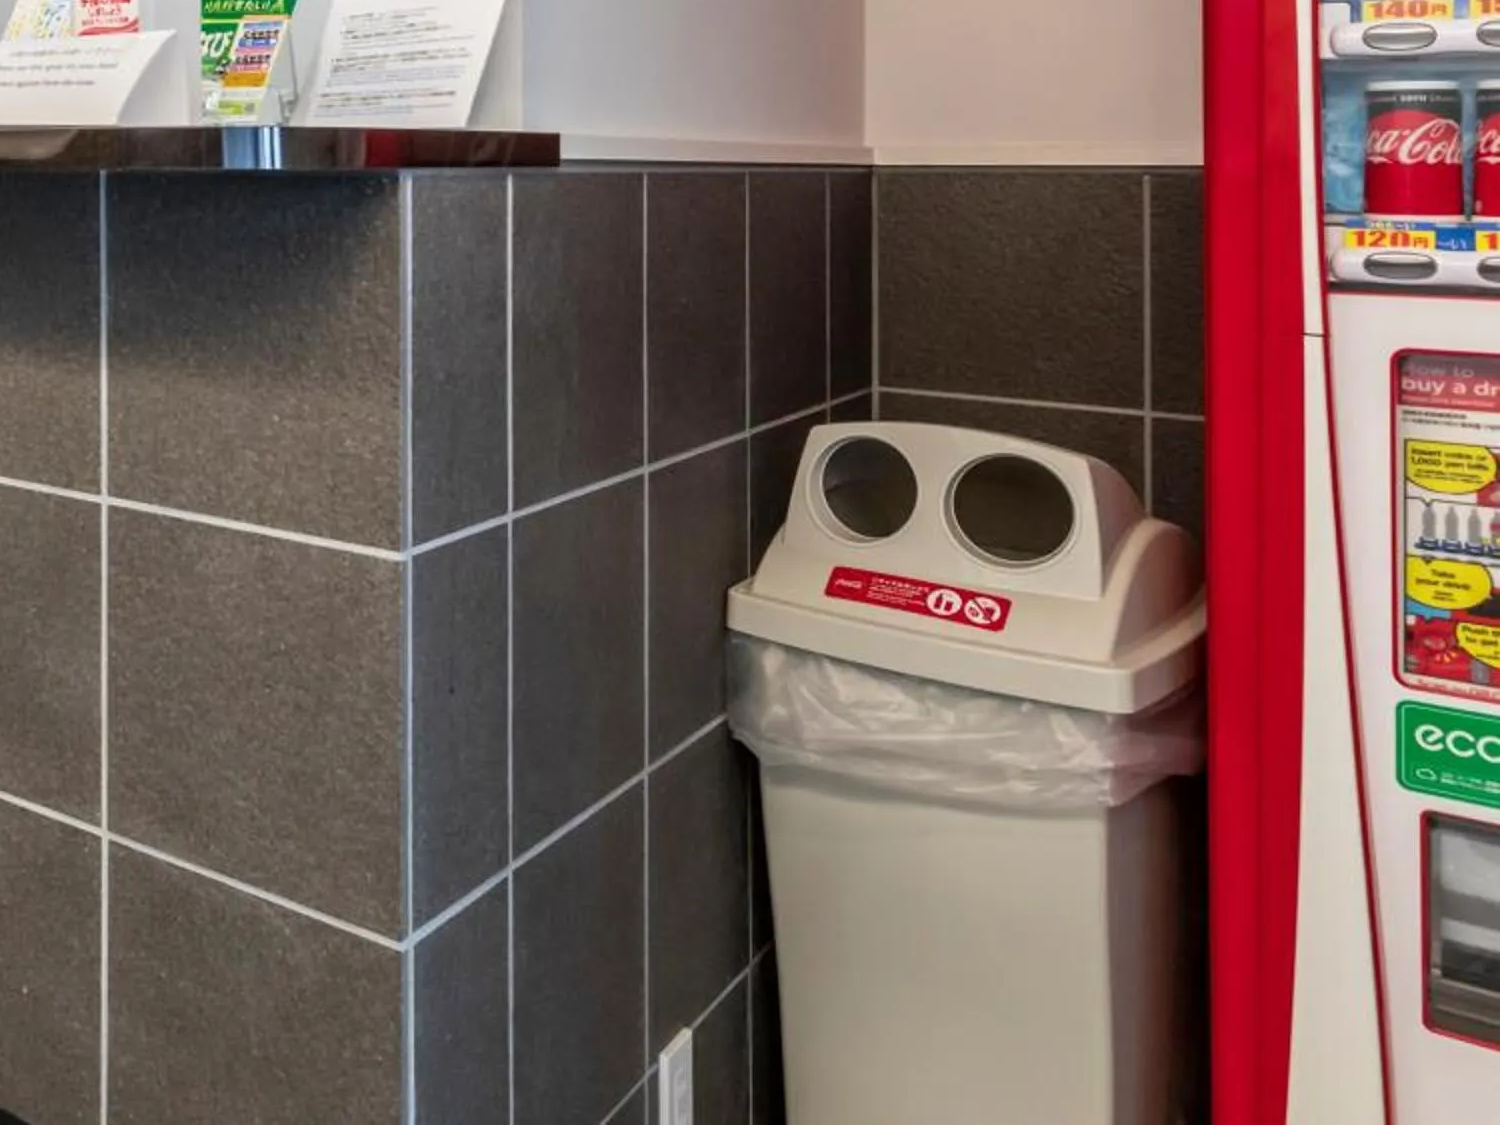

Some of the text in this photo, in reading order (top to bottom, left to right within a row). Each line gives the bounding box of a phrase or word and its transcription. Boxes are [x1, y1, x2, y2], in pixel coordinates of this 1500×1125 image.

[1368, 0, 1448, 18] 140円
[1350, 231, 1429, 248] 120円
[1401, 376, 1445, 396] buy
[1452, 382, 1467, 394] a
